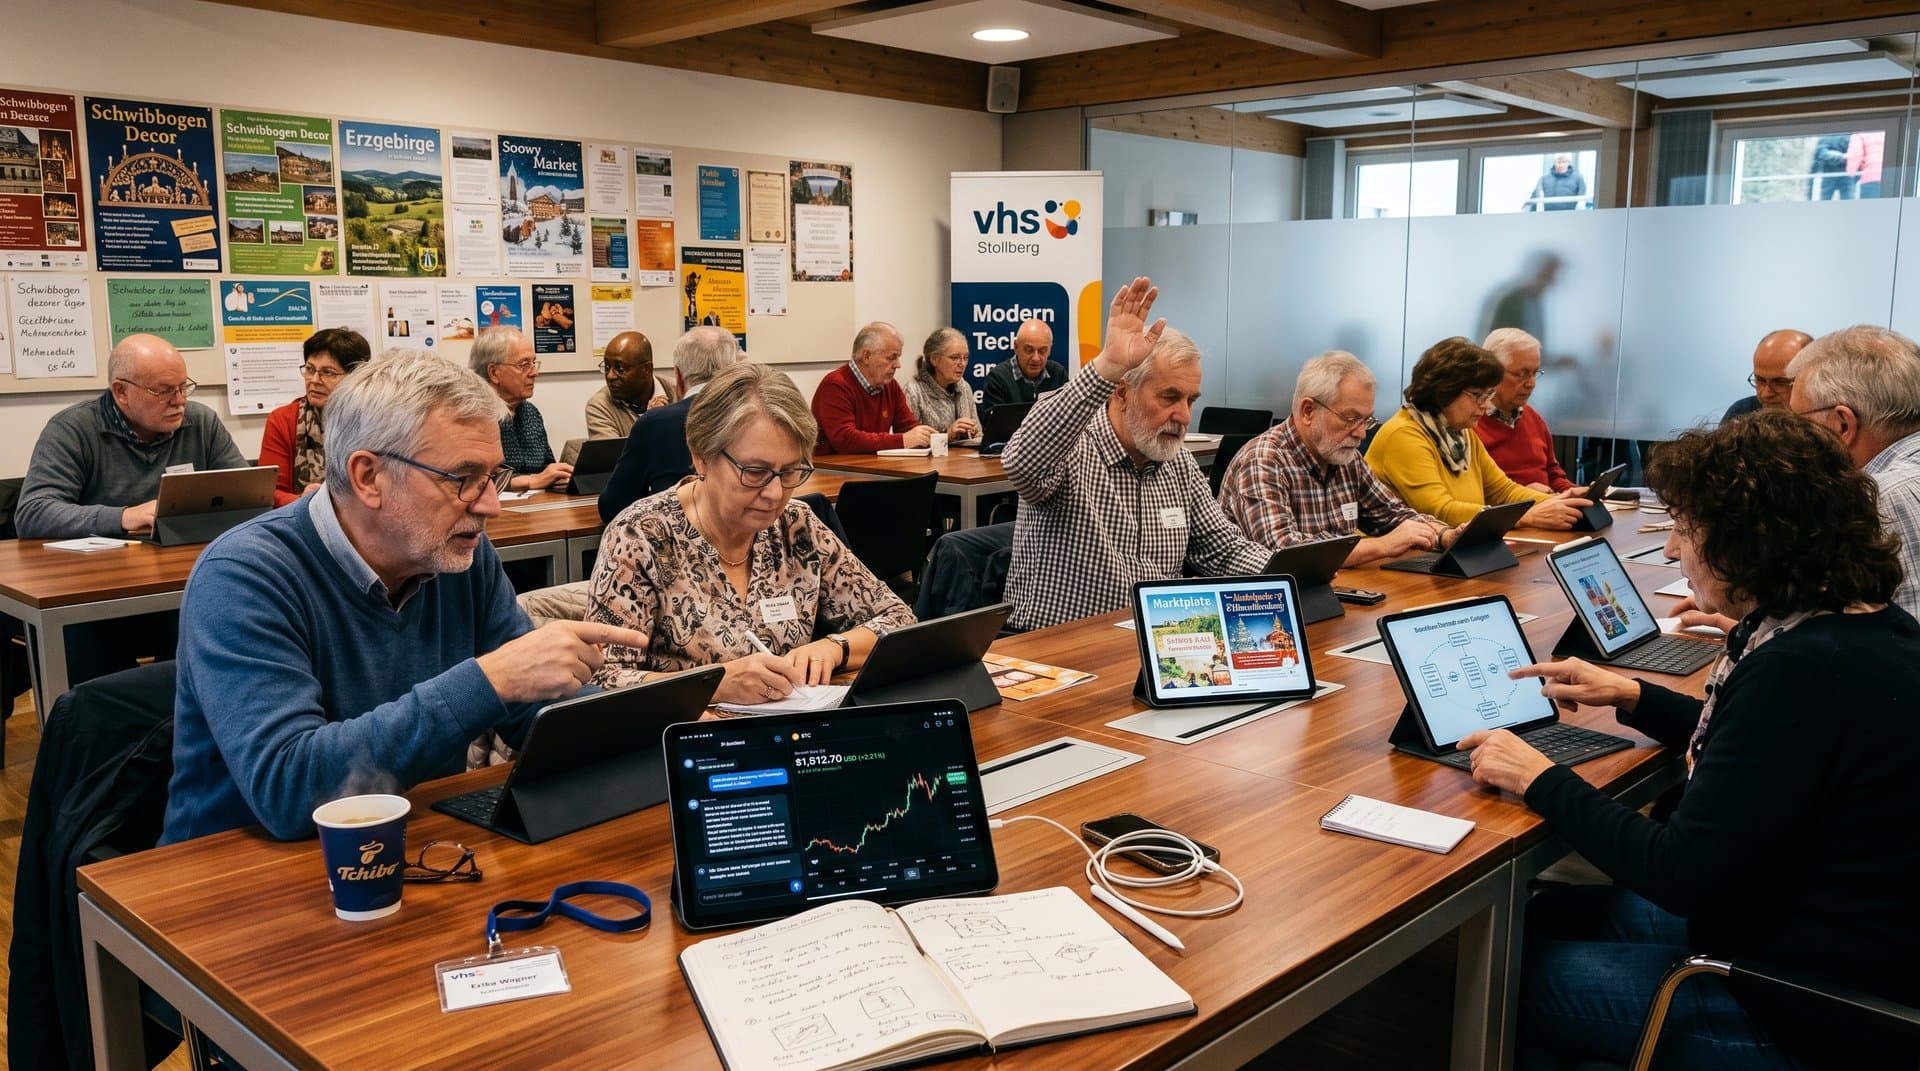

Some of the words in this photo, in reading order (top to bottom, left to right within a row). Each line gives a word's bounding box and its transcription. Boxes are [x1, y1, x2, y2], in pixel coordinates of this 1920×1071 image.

[0, 96, 68, 114] Schwibbogen
[91, 103, 208, 131] Schwibbogen
[124, 125, 177, 145] Decor
[226, 122, 298, 140] Schwibbogen
[300, 128, 330, 140] Decor
[345, 128, 435, 155] Erzgebirge
[502, 140, 541, 157] Soowy
[533, 156, 578, 172] Market
[973, 201, 1040, 234] vhs
[977, 241, 1040, 256] Stollberg
[17, 282, 80, 298] Schwibbogen
[973, 303, 1055, 323] Modern
[843, 755, 857, 763] USD
[337, 861, 400, 881] Tchibo
[451, 972, 475, 980] vhs
